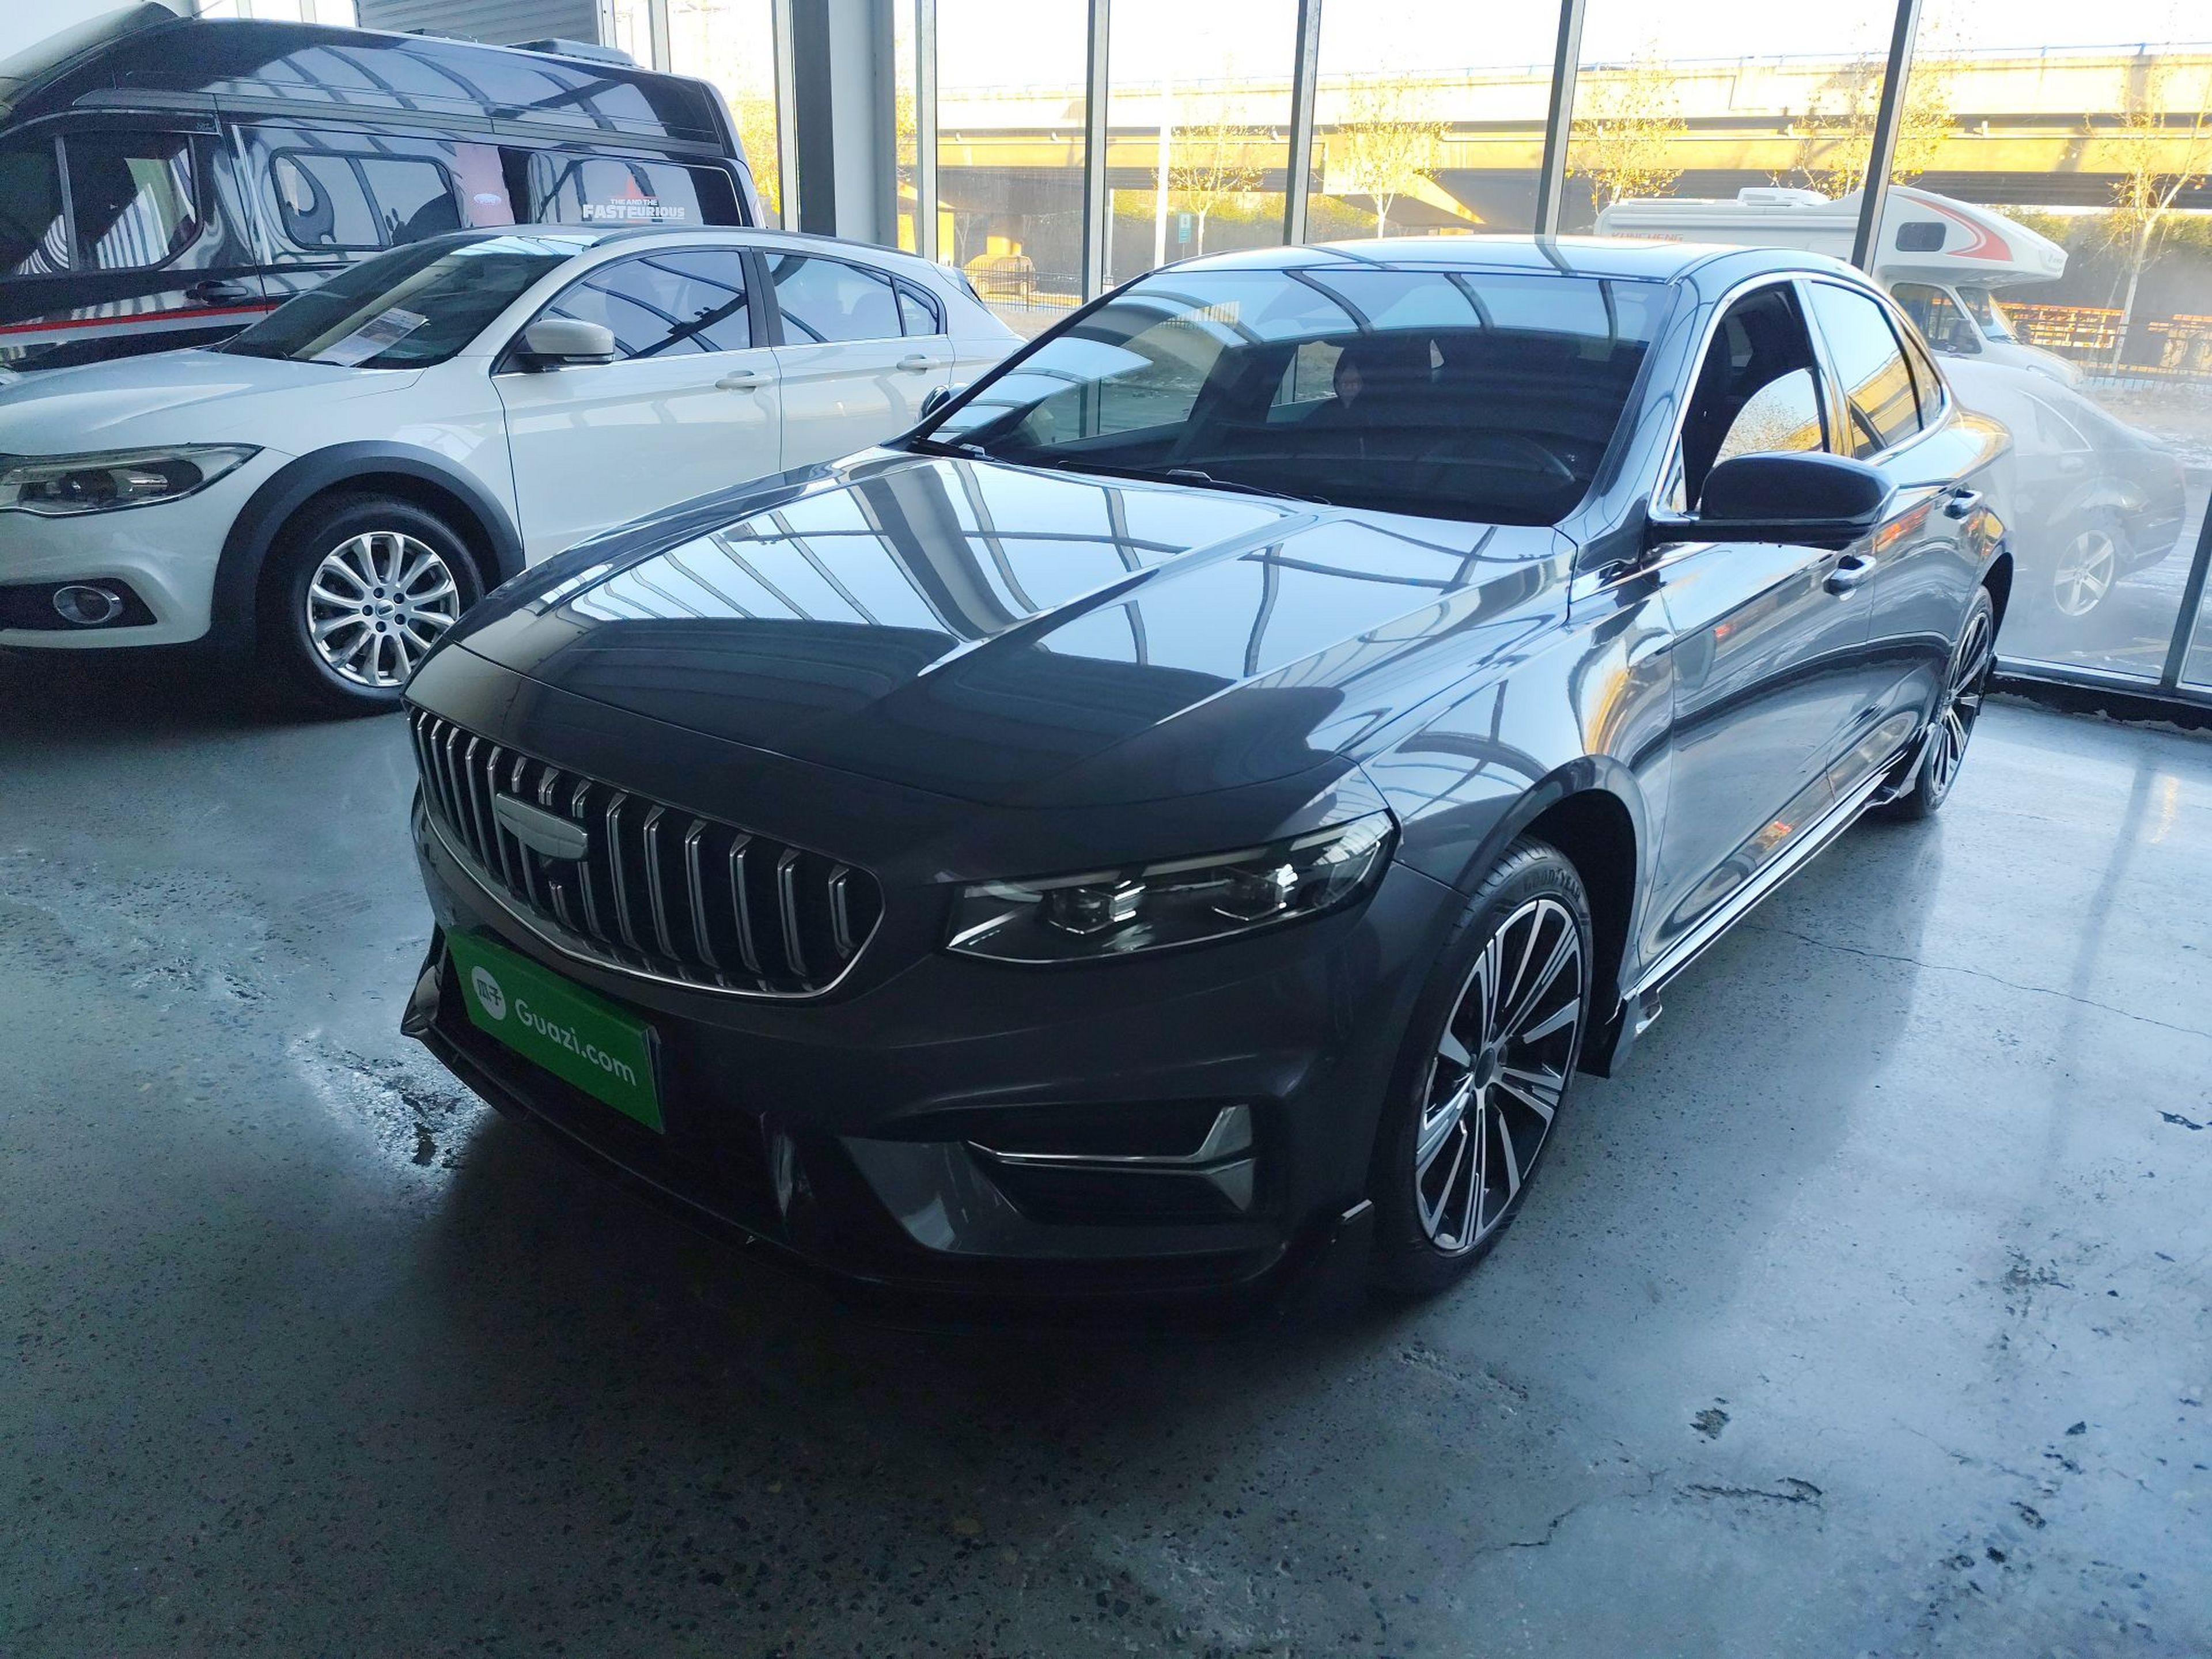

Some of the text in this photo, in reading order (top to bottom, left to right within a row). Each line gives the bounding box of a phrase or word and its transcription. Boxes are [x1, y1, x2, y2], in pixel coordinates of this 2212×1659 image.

[582, 204, 685, 220] FAST FURIOUS
[476, 979, 502, 1007] 瓜子
[514, 998, 637, 1086] Guazi.com
